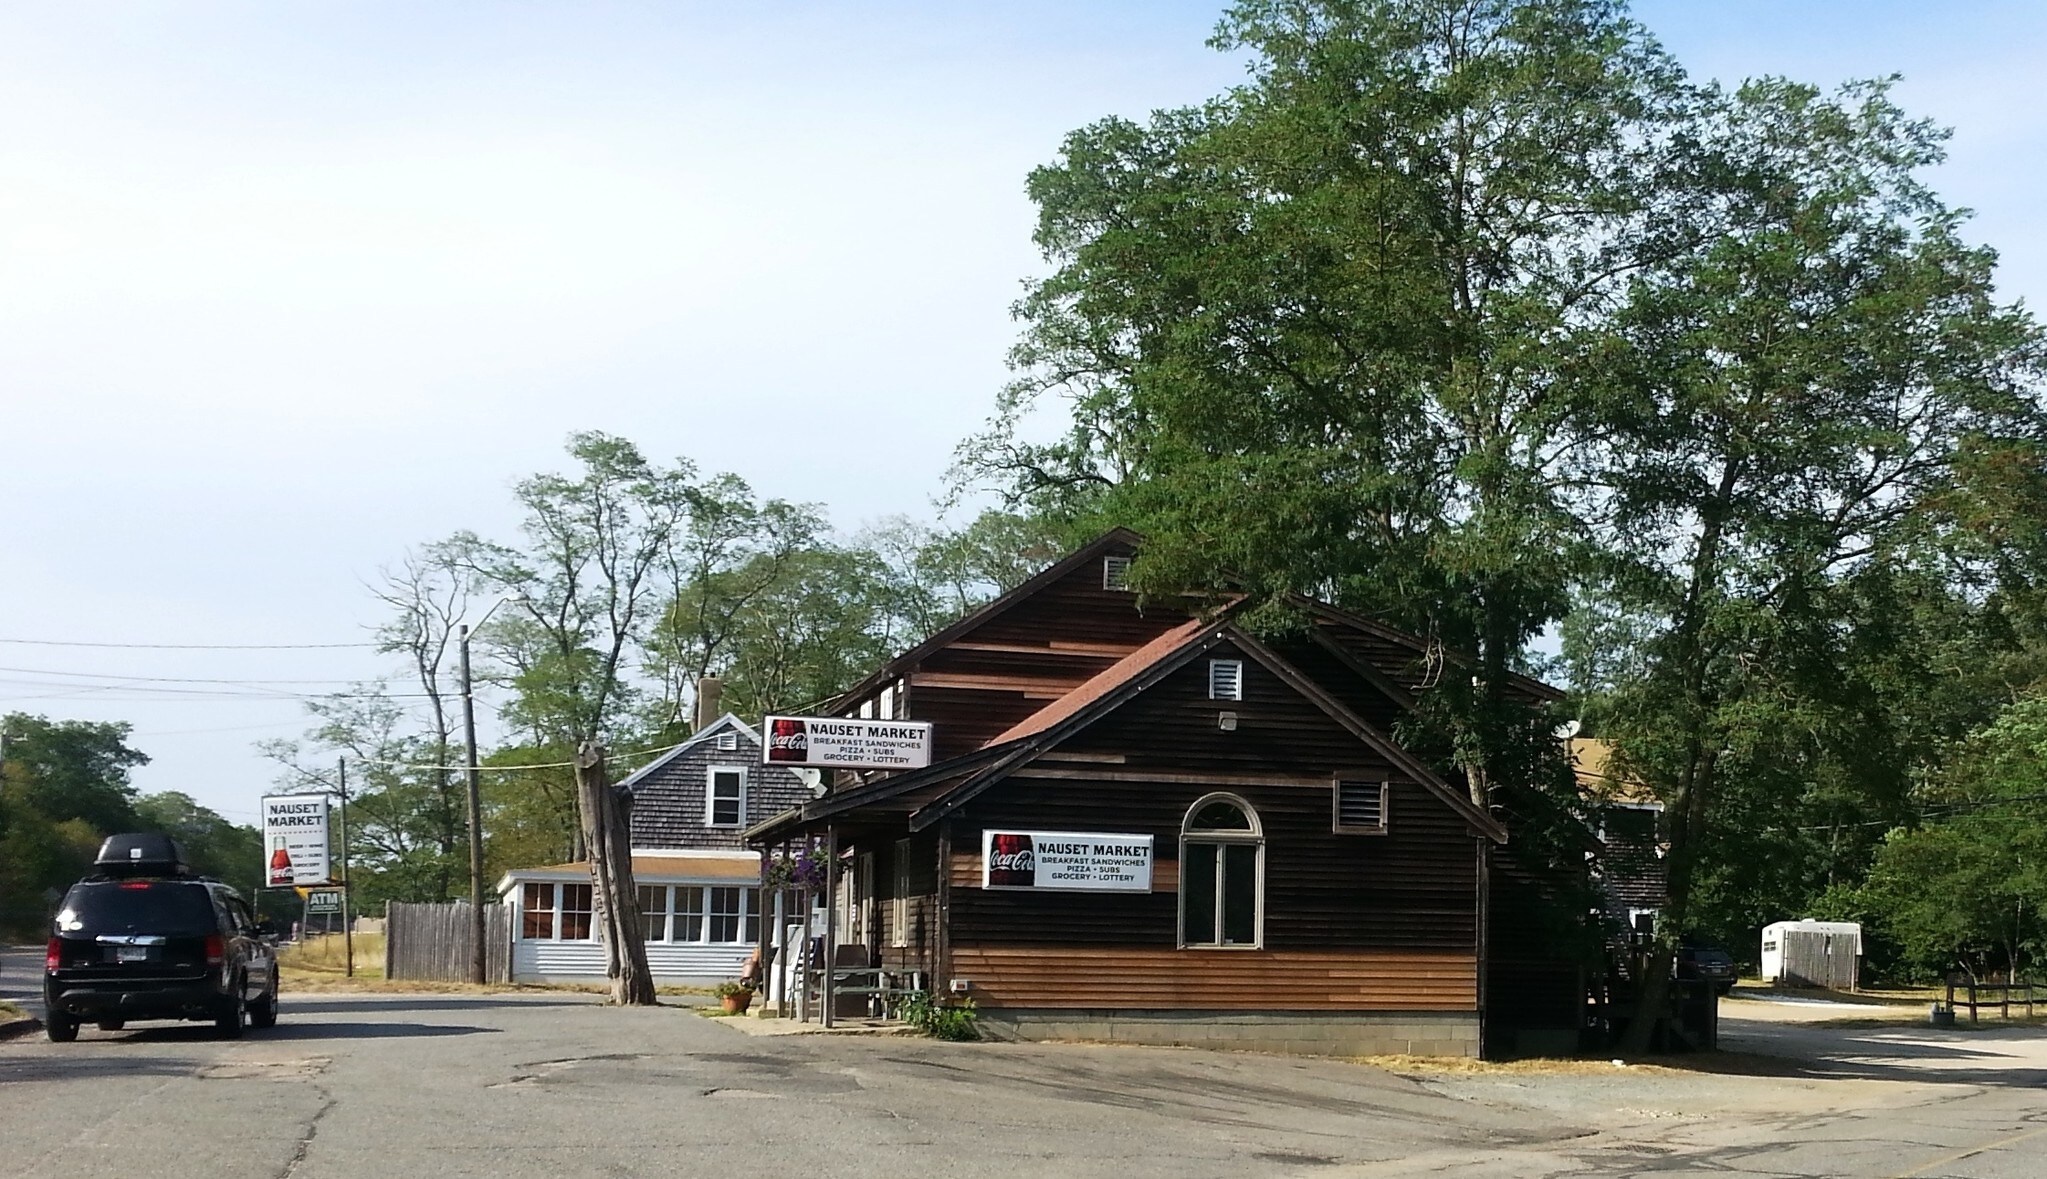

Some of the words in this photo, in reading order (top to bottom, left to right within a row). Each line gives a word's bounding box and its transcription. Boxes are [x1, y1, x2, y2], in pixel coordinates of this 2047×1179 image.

[810, 723, 863, 737] NAUSET
[867, 726, 926, 740] MARKET
[813, 738, 863, 746] BREAKFAST
[865, 740, 921, 749] SANDWICHES
[873, 748, 895, 756] SUBS
[823, 753, 864, 762] GROCERY
[872, 756, 910, 764] LOTTERY
[270, 803, 319, 815] NAUSET
[267, 816, 322, 827] MARKET
[1038, 842, 1089, 855] NAUSET
[1093, 844, 1149, 857] MARKET
[1041, 856, 1088, 865] BREAKFAST
[1090, 858, 1145, 867] SANDWICHES
[1099, 866, 1121, 874] SUBS
[1051, 872, 1091, 881] GROCERY
[1098, 874, 1135, 882] LOTTERY
[309, 892, 339, 905] ATM
